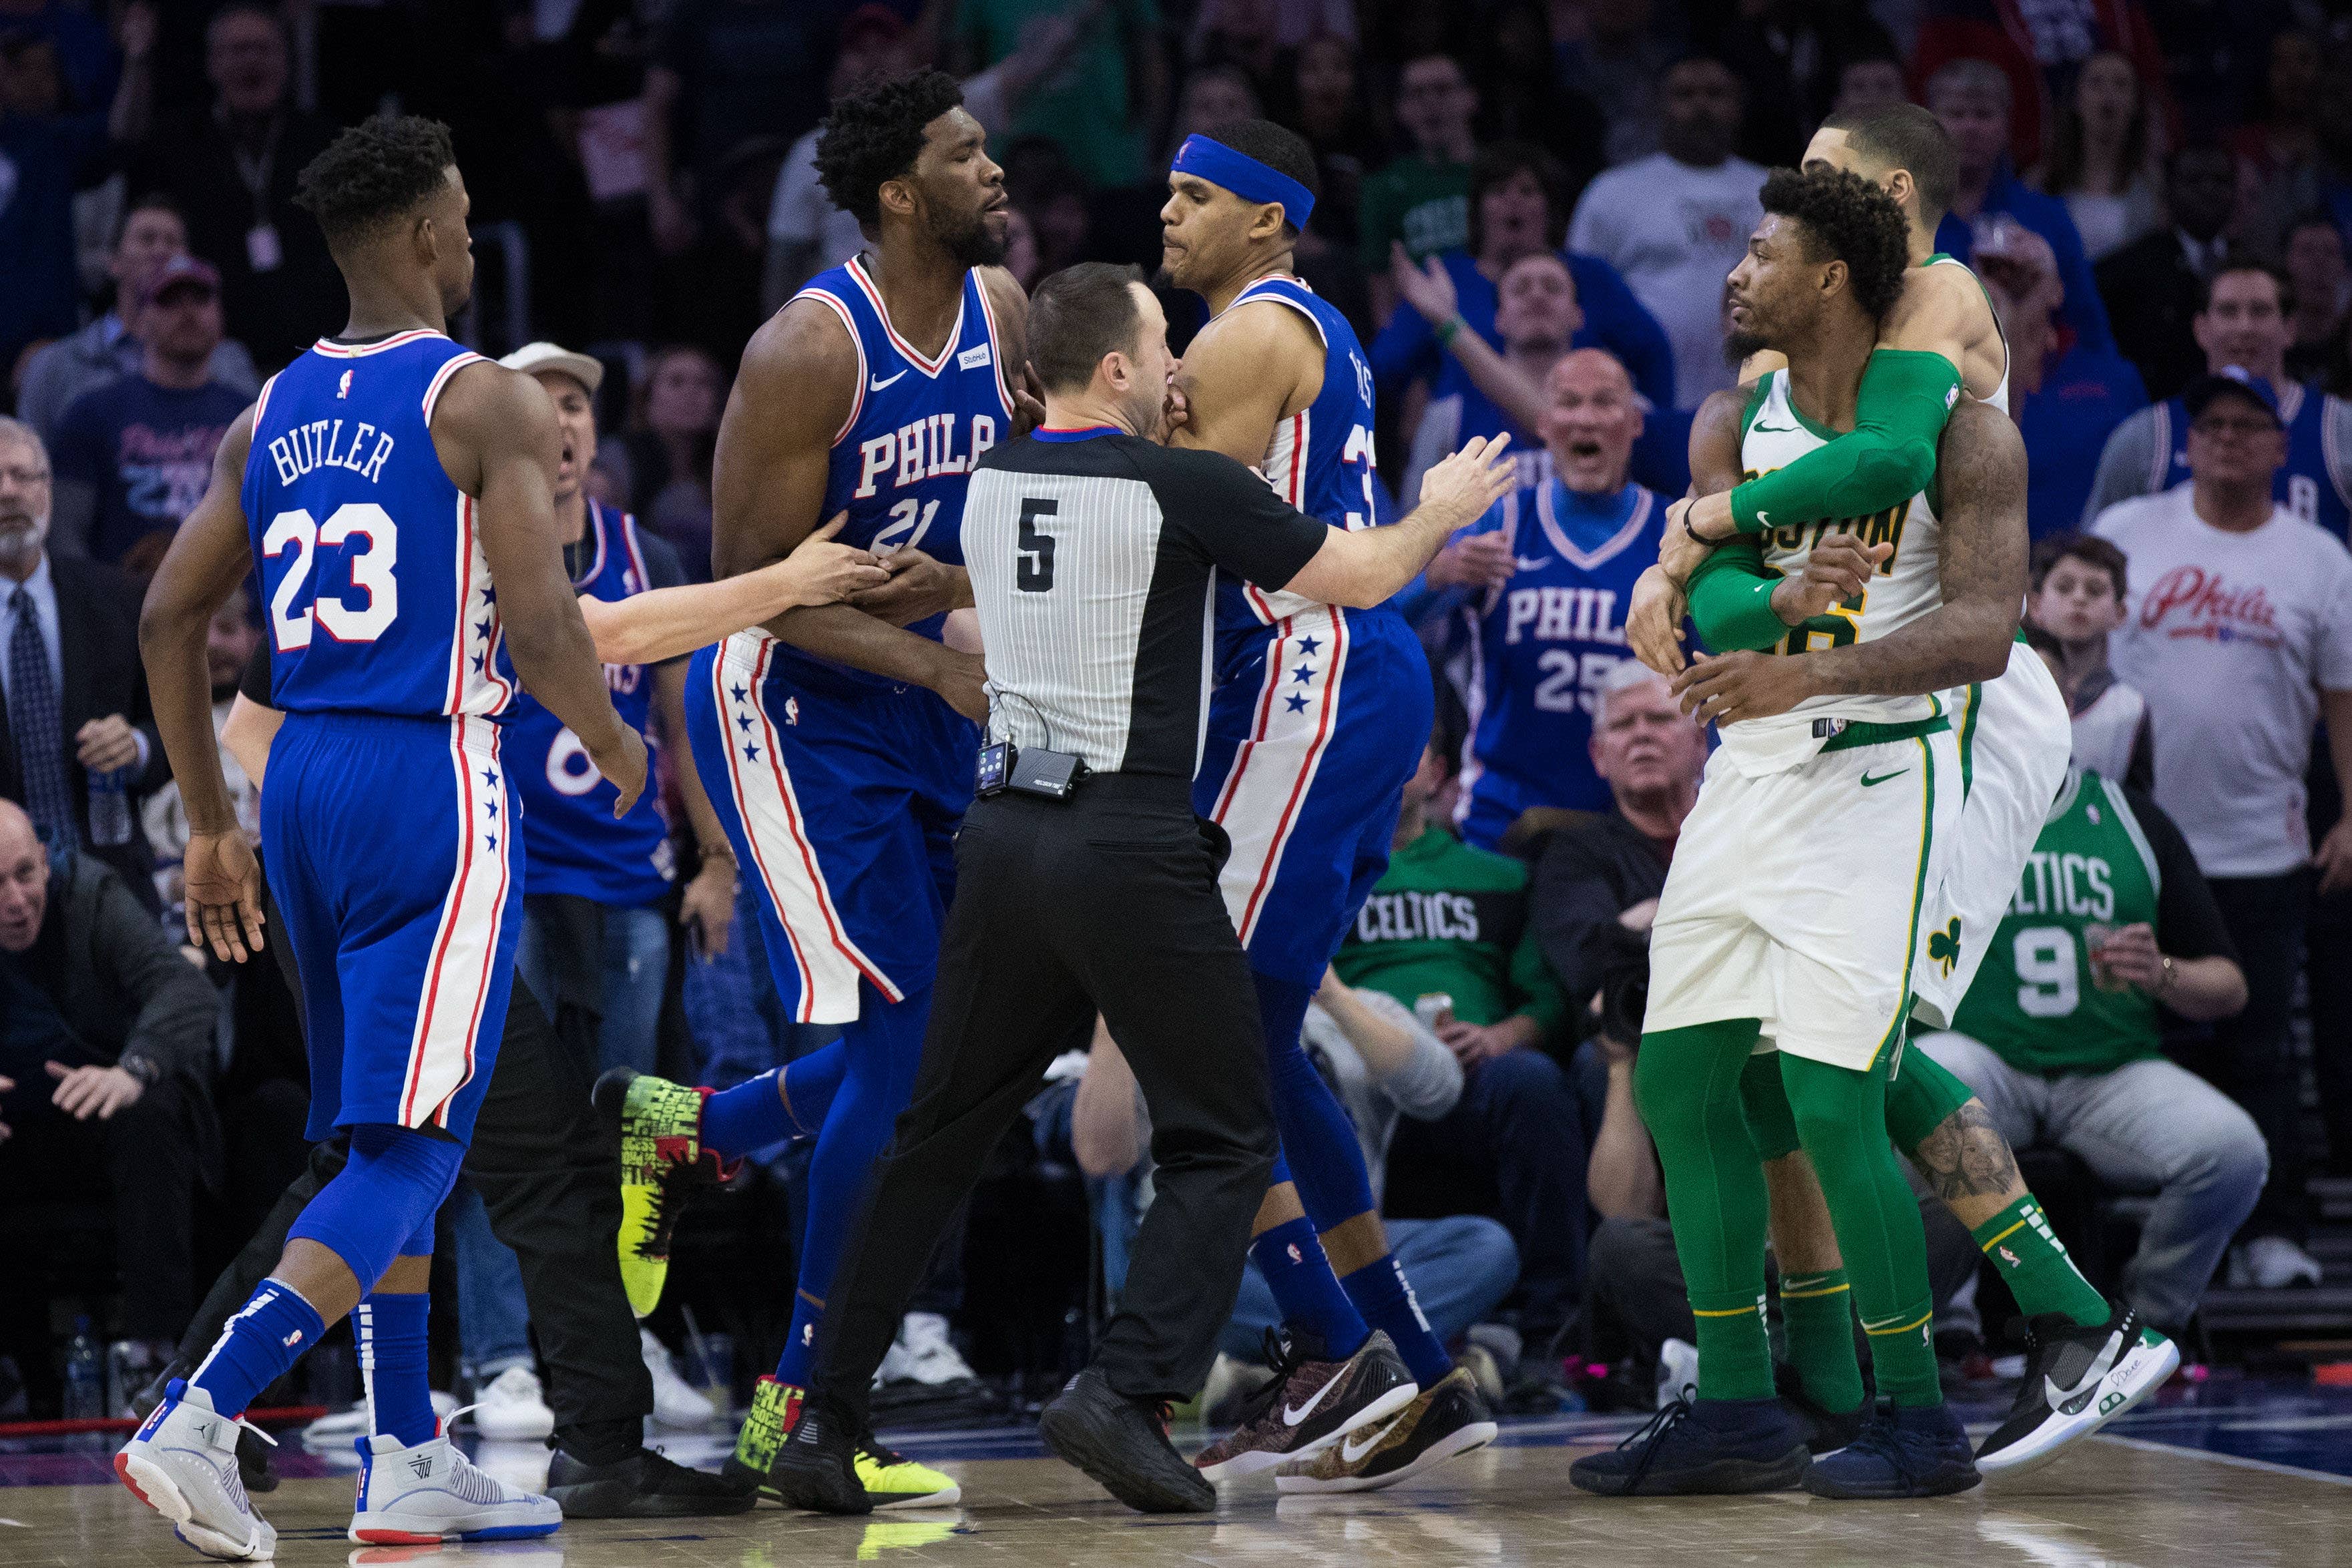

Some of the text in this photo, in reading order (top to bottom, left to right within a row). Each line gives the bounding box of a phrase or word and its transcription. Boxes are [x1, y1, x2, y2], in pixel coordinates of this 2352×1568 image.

[268, 419, 395, 487] BUTLER
[869, 499, 941, 559] 21
[1017, 497, 1059, 593] 5
[262, 503, 398, 654] 23
[1505, 587, 1627, 645] PHIL
[1534, 648, 1620, 716] 25
[1358, 892, 1479, 943] CELTICS
[2013, 926, 2079, 1017] 9
